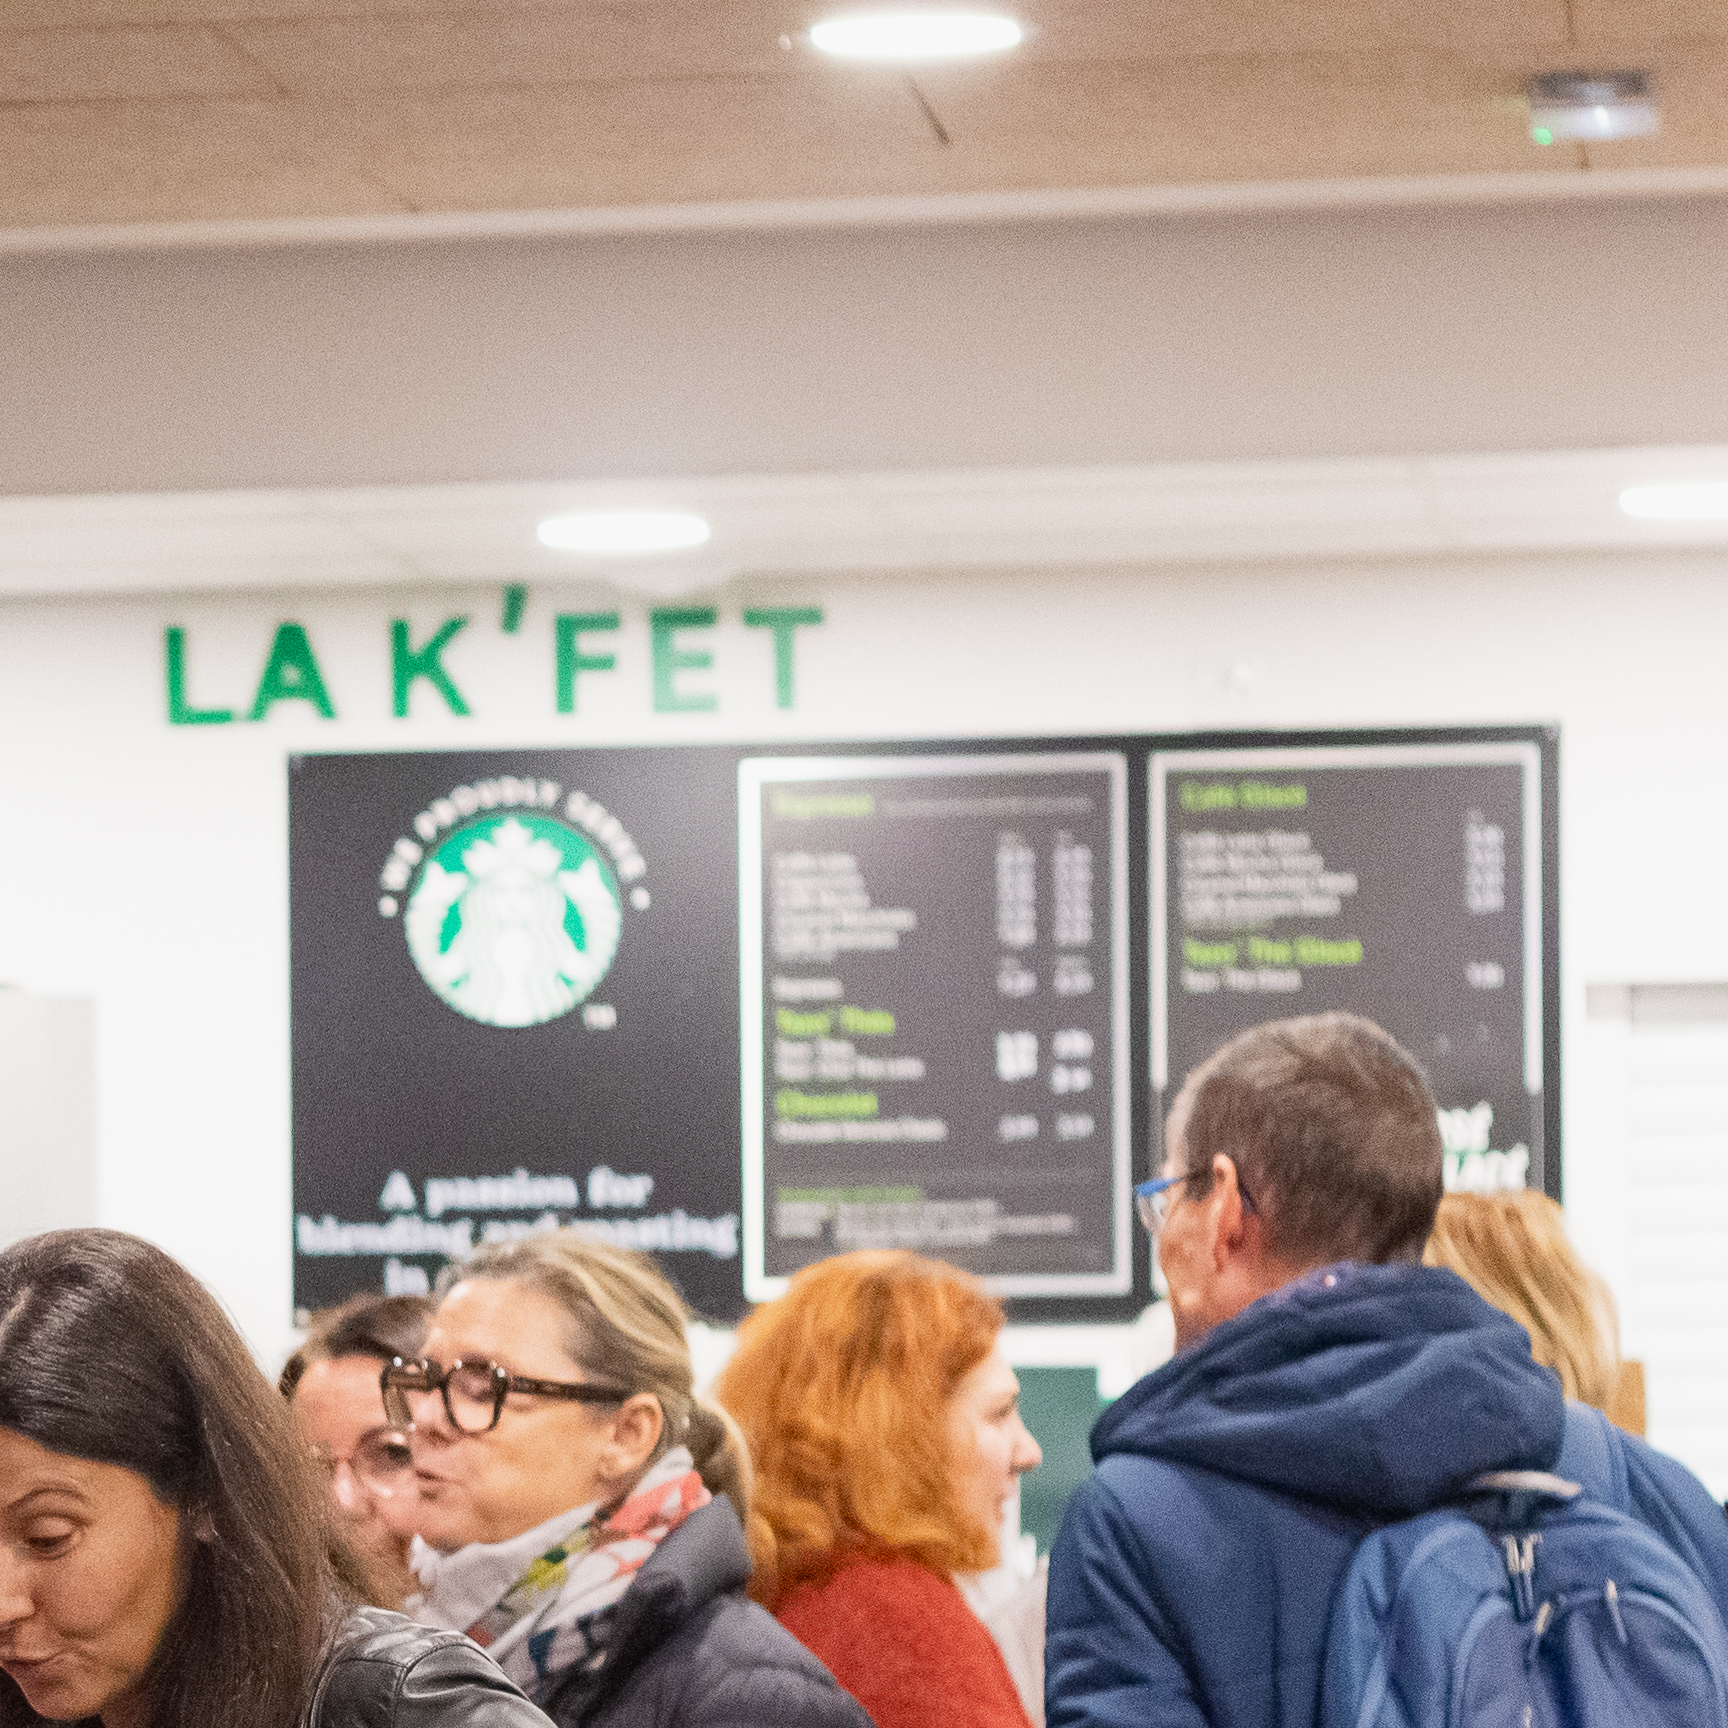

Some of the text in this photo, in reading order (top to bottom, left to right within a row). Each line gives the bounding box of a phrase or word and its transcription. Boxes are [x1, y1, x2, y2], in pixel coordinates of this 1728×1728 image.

[163, 584, 824, 726] LA K'FET
[379, 775, 646, 891] WE PROUDLY SERVE
[380, 1164, 655, 1218] A passion for
[296, 1212, 476, 1263] blending
